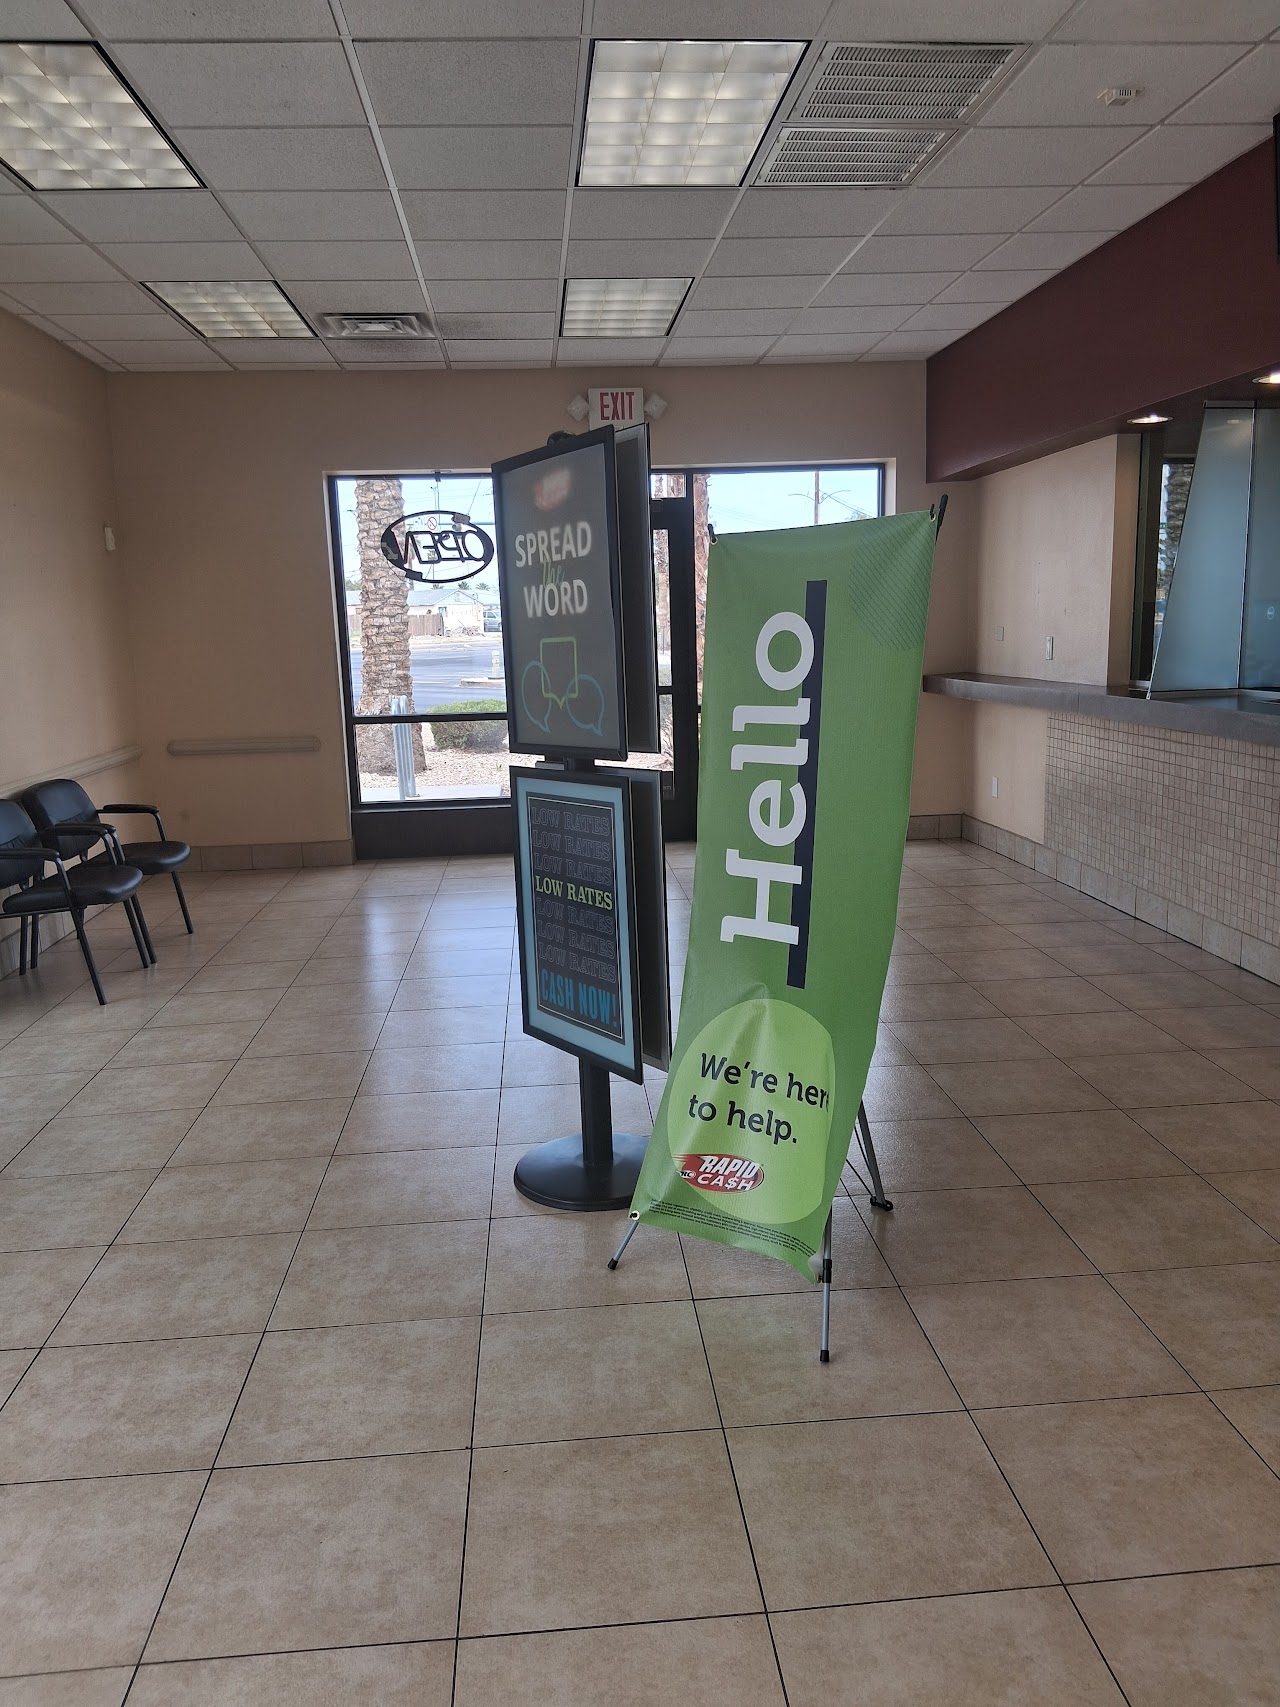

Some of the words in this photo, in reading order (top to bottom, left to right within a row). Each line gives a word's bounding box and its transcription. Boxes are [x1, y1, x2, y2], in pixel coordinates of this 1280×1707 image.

[599, 391, 635, 421] EXIT
[514, 520, 593, 568] SPREAD
[523, 578, 589, 619] WORD
[719, 611, 815, 946] Hello
[531, 806, 561, 828] LOW
[563, 811, 610, 837] RATES
[532, 829, 562, 852] LOW
[564, 835, 611, 862] RATES
[533, 852, 563, 875] LOW
[565, 858, 613, 887] RATES
[535, 875, 564, 898] LOW
[566, 882, 613, 911] RATES
[535, 896, 565, 921] LOW
[567, 905, 614, 936] RATES
[537, 919, 566, 944] LOW
[568, 928, 616, 960] RATES
[538, 941, 567, 967] LOW
[569, 952, 617, 984] RATES
[541, 967, 575, 1012] CASH
[578, 981, 618, 1028] NOW!
[700, 1052, 778, 1094] We're
[688, 1094, 717, 1122] to
[726, 1100, 797, 1146] help.
[698, 1155, 760, 1180] RAPID
